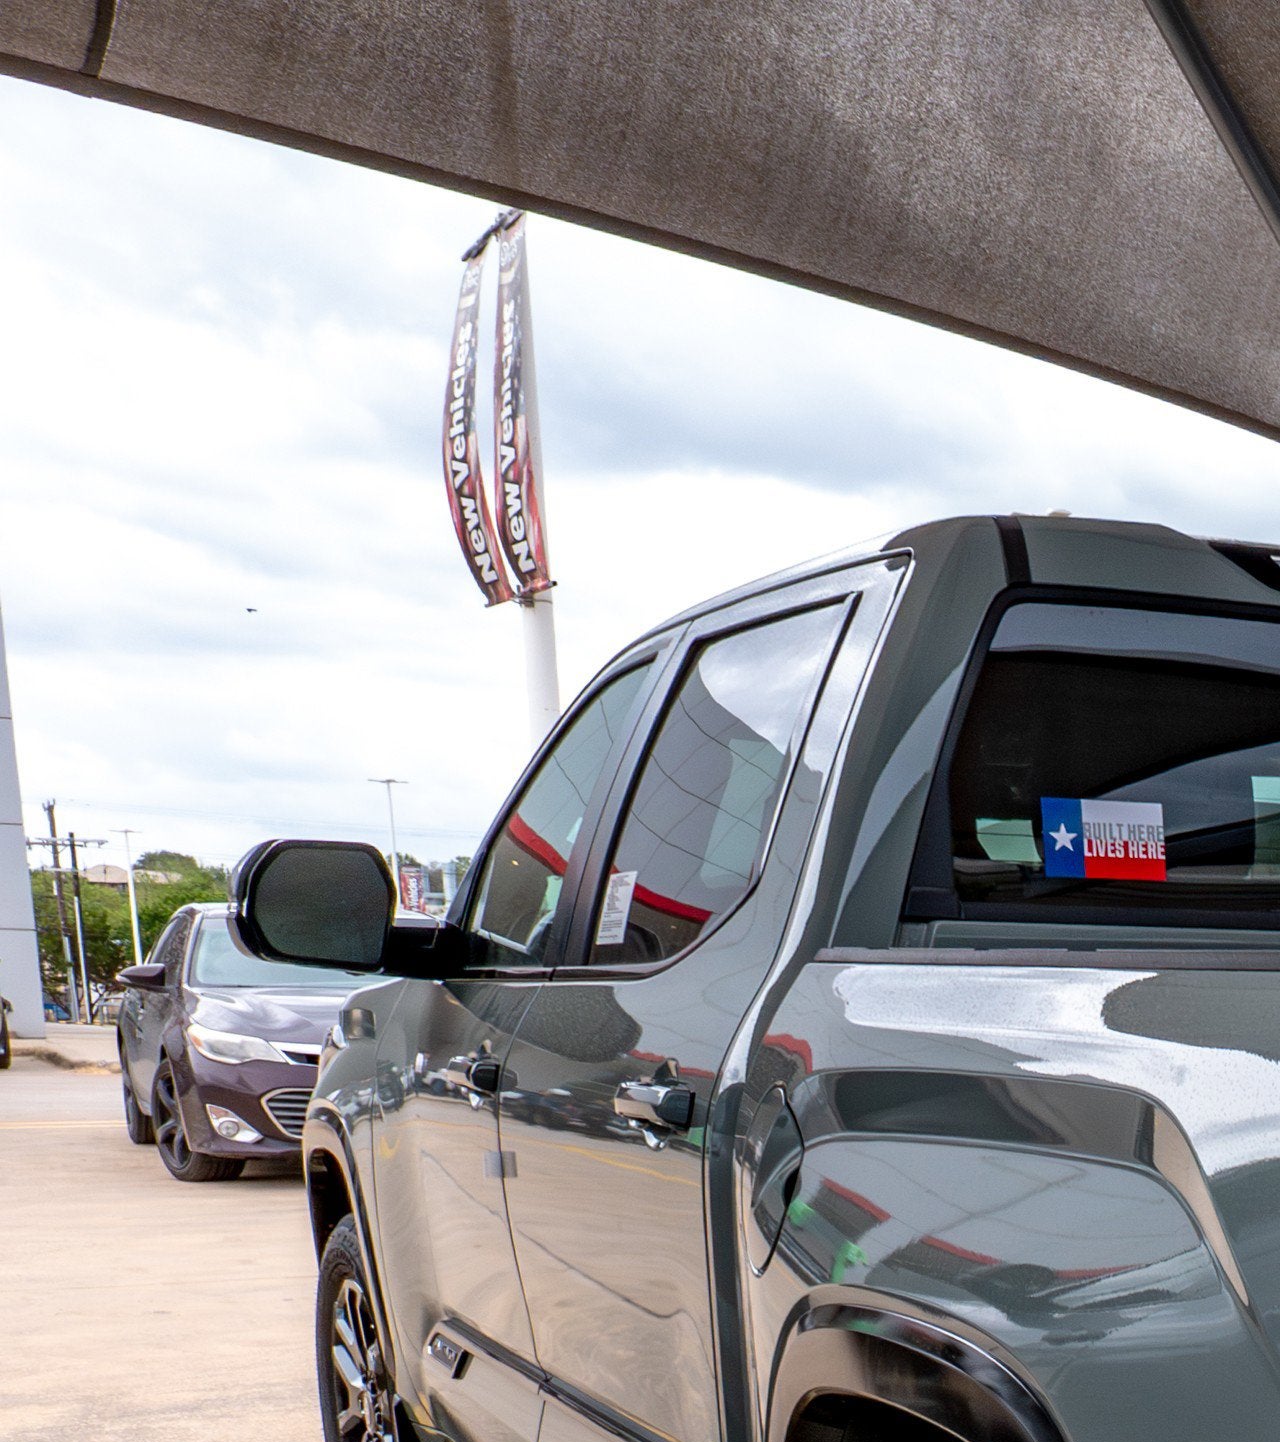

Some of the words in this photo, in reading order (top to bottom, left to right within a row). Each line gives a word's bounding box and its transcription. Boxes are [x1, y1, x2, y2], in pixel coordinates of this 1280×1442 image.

[449, 321, 474, 490] Vehicles
[500, 298, 518, 475] Vehicles
[460, 497, 498, 585] New
[502, 481, 537, 573] New
[1083, 822, 1124, 842] BUILT
[1127, 824, 1164, 843] HERE
[1084, 839, 1125, 858] LIVES
[1128, 840, 1166, 860] HERE
